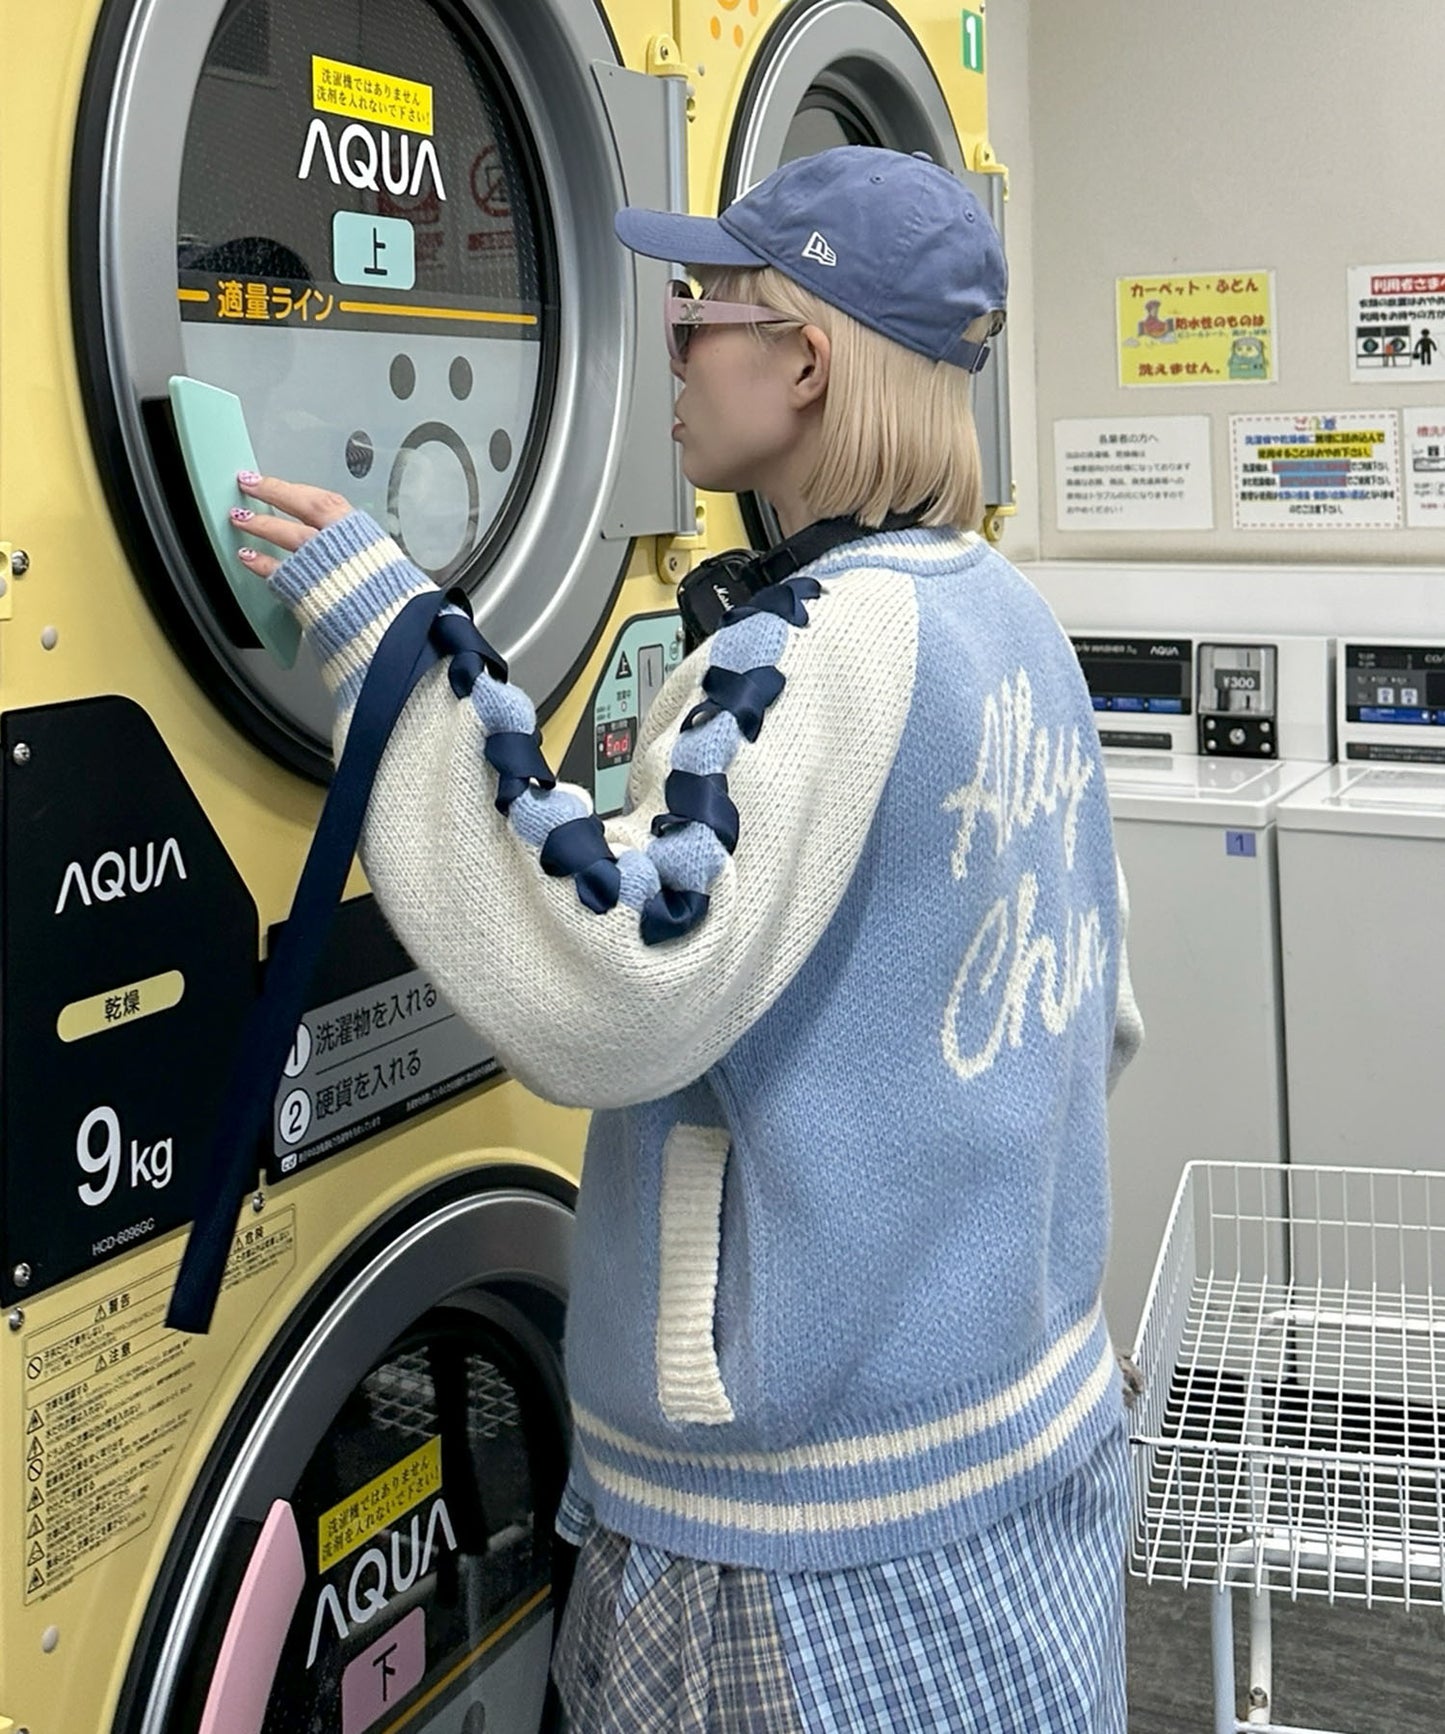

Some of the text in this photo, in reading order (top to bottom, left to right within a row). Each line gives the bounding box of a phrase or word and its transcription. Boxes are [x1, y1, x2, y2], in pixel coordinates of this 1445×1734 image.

[966, 15, 977, 69] 1
[321, 68, 420, 106] 洗濯機ではありません
[298, 118, 447, 201] AQUA
[364, 227, 388, 276] 上
[217, 280, 334, 322] 適量ライン
[1131, 277, 1259, 298] カーペット・ふとん
[1175, 314, 1265, 330] 防水性のものは
[1150, 645, 1180, 656] AQUA
[1235, 833, 1245, 852] 1
[55, 837, 187, 914] AQUA
[104, 989, 141, 1023] 乾燥
[315, 983, 437, 1057] 洗濯物を入れる
[315, 1048, 421, 1120] 硬貨を入れる
[76, 1105, 173, 1206] 9 kg
[306, 1498, 458, 1670] AQUA
[373, 1642, 397, 1702] 下
